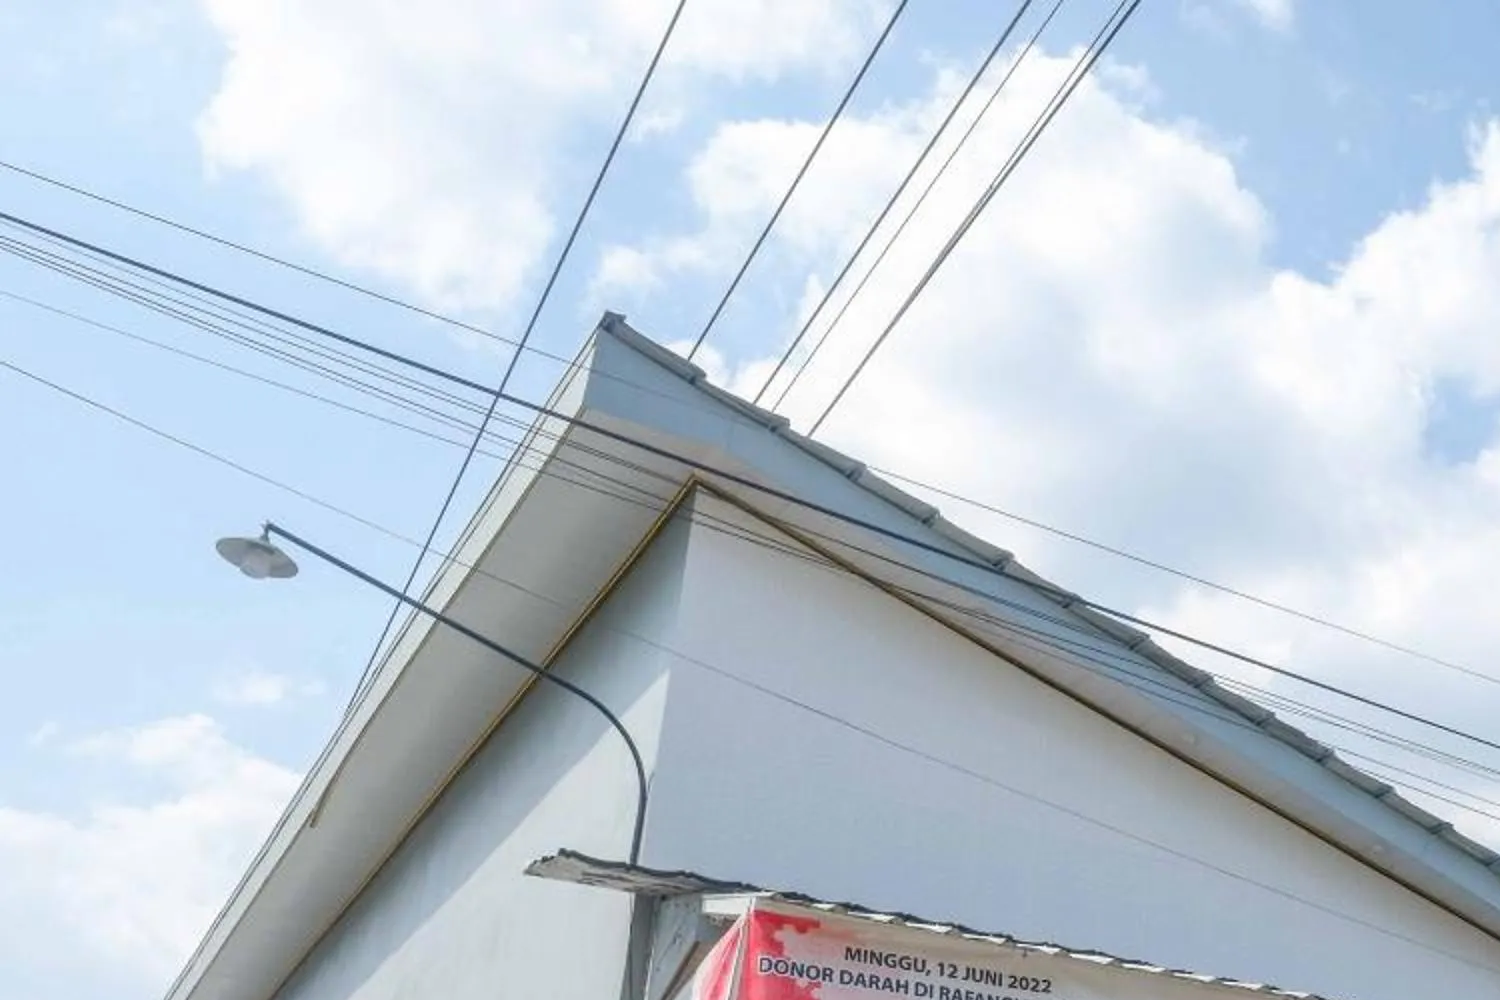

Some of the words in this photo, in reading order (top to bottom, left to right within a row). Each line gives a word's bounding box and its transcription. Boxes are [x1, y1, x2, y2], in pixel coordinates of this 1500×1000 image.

[758, 956, 834, 982] DONOR
[839, 969, 909, 995] DARAH
[914, 981, 934, 999] DI
[844, 947, 931, 977] MINGGU,
[937, 962, 958, 979] 12
[962, 966, 1003, 987] JUNI
[1007, 975, 1053, 994] 2022
